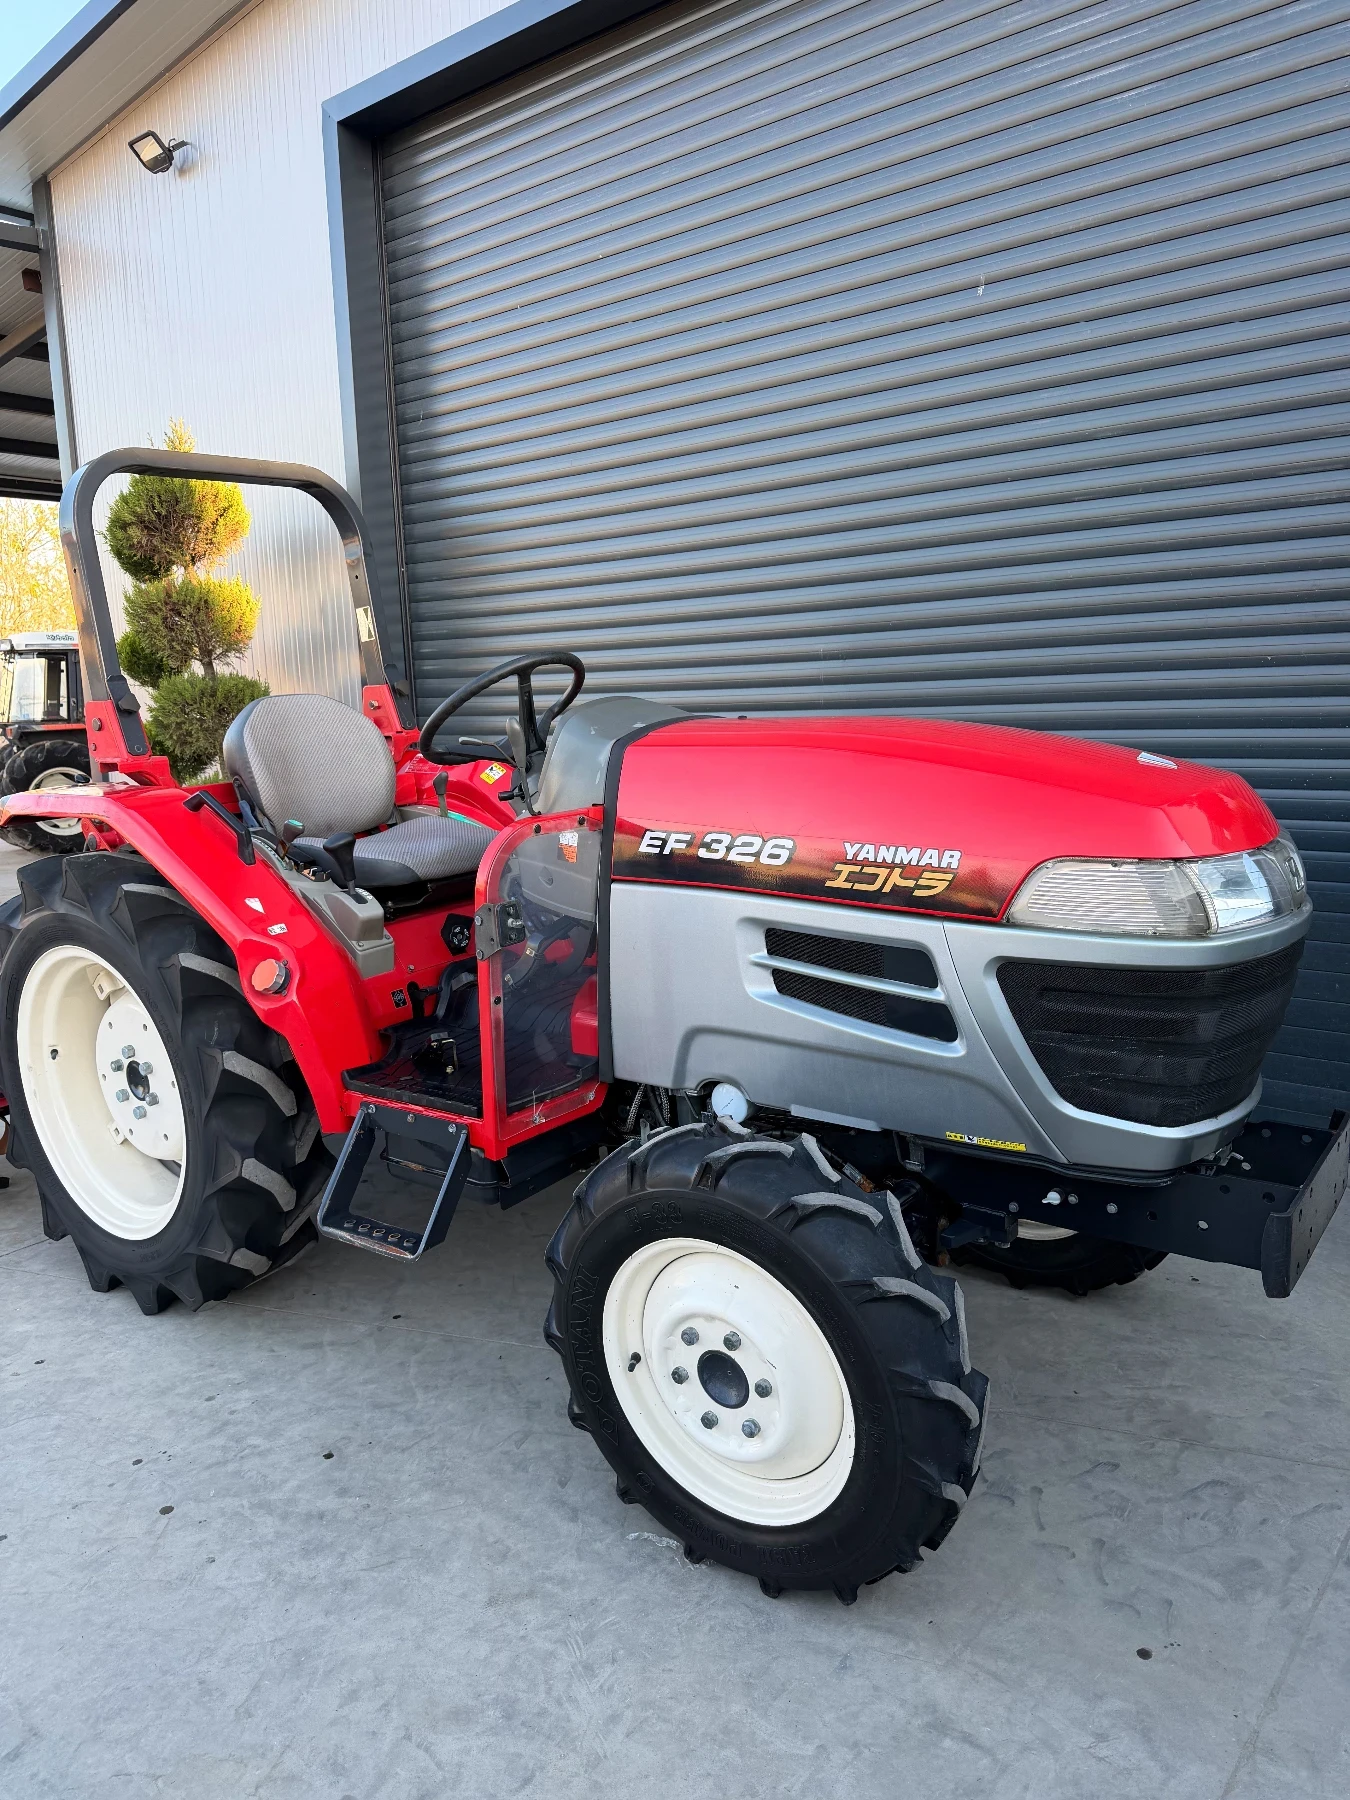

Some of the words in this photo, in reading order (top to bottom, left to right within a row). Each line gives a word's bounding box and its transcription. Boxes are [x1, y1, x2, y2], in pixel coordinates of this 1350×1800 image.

[45, 634, 75, 642] Kubota
[638, 830, 692, 855] EF
[697, 832, 795, 865] 326
[843, 842, 962, 869] YANMAR
[825, 863, 955, 897] エコトラ
[569, 1262, 604, 1403] OTANI
